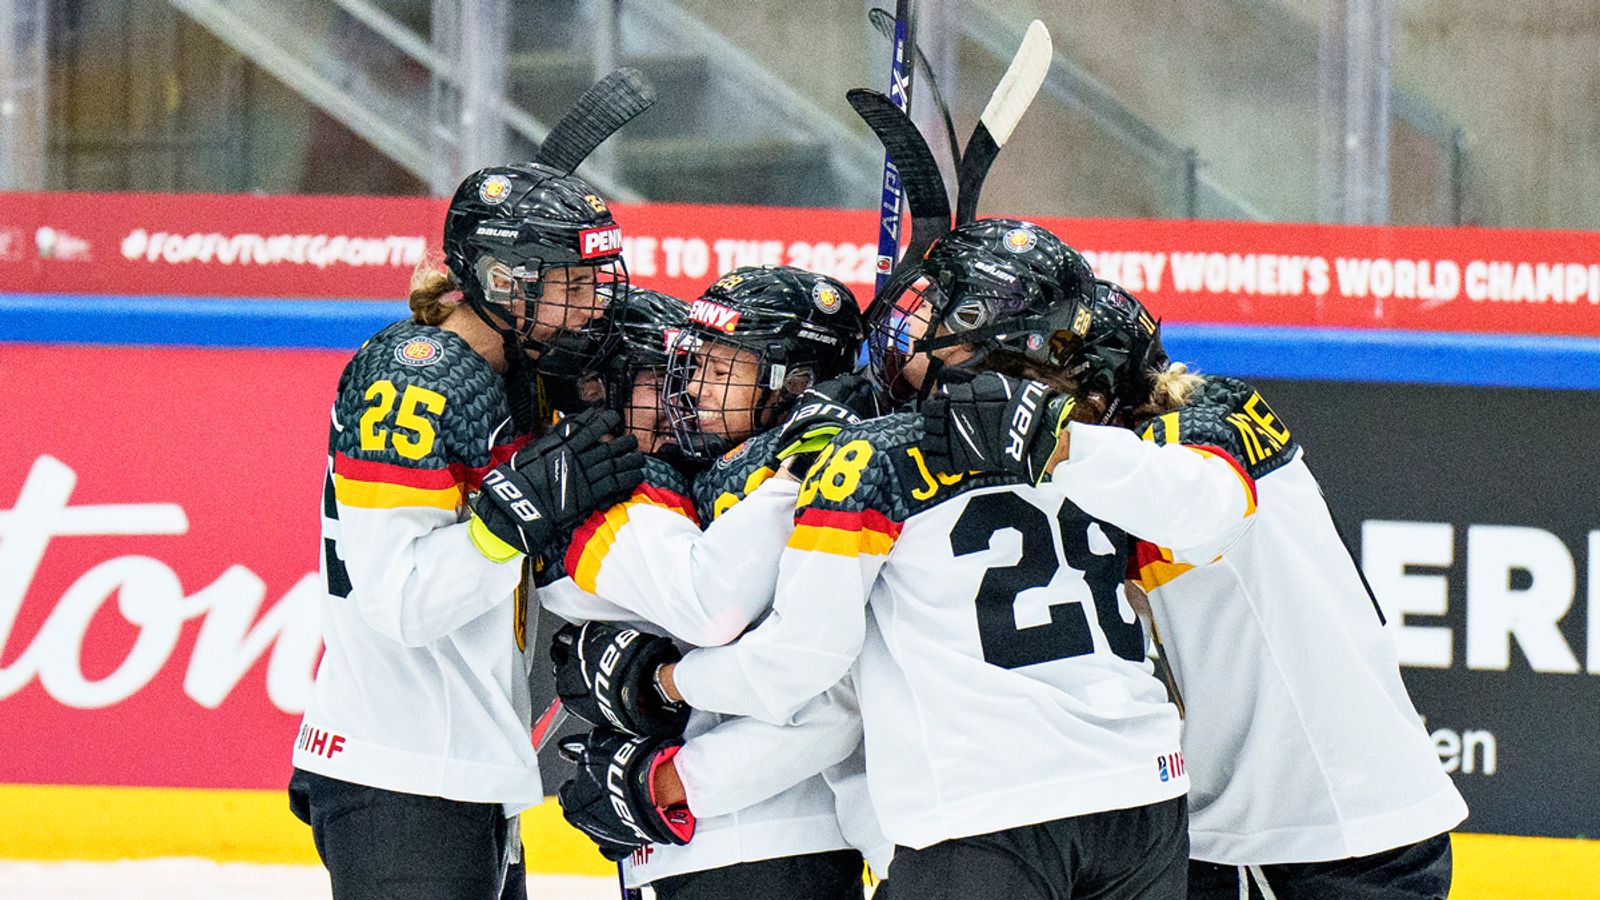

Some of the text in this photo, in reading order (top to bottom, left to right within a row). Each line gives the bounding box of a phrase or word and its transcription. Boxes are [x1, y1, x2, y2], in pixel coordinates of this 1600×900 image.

[662, 236, 710, 279] TO
[713, 239, 784, 277] THE
[786, 240, 876, 284] 2022
[1171, 250, 1330, 296] WOMEN'S
[1335, 256, 1460, 302] WORLD
[1465, 258, 1600, 305] CHAMPI
[1073, 308, 1091, 336] 28
[359, 379, 447, 461] 25
[796, 439, 873, 508] 28
[949, 490, 1145, 670] 28
